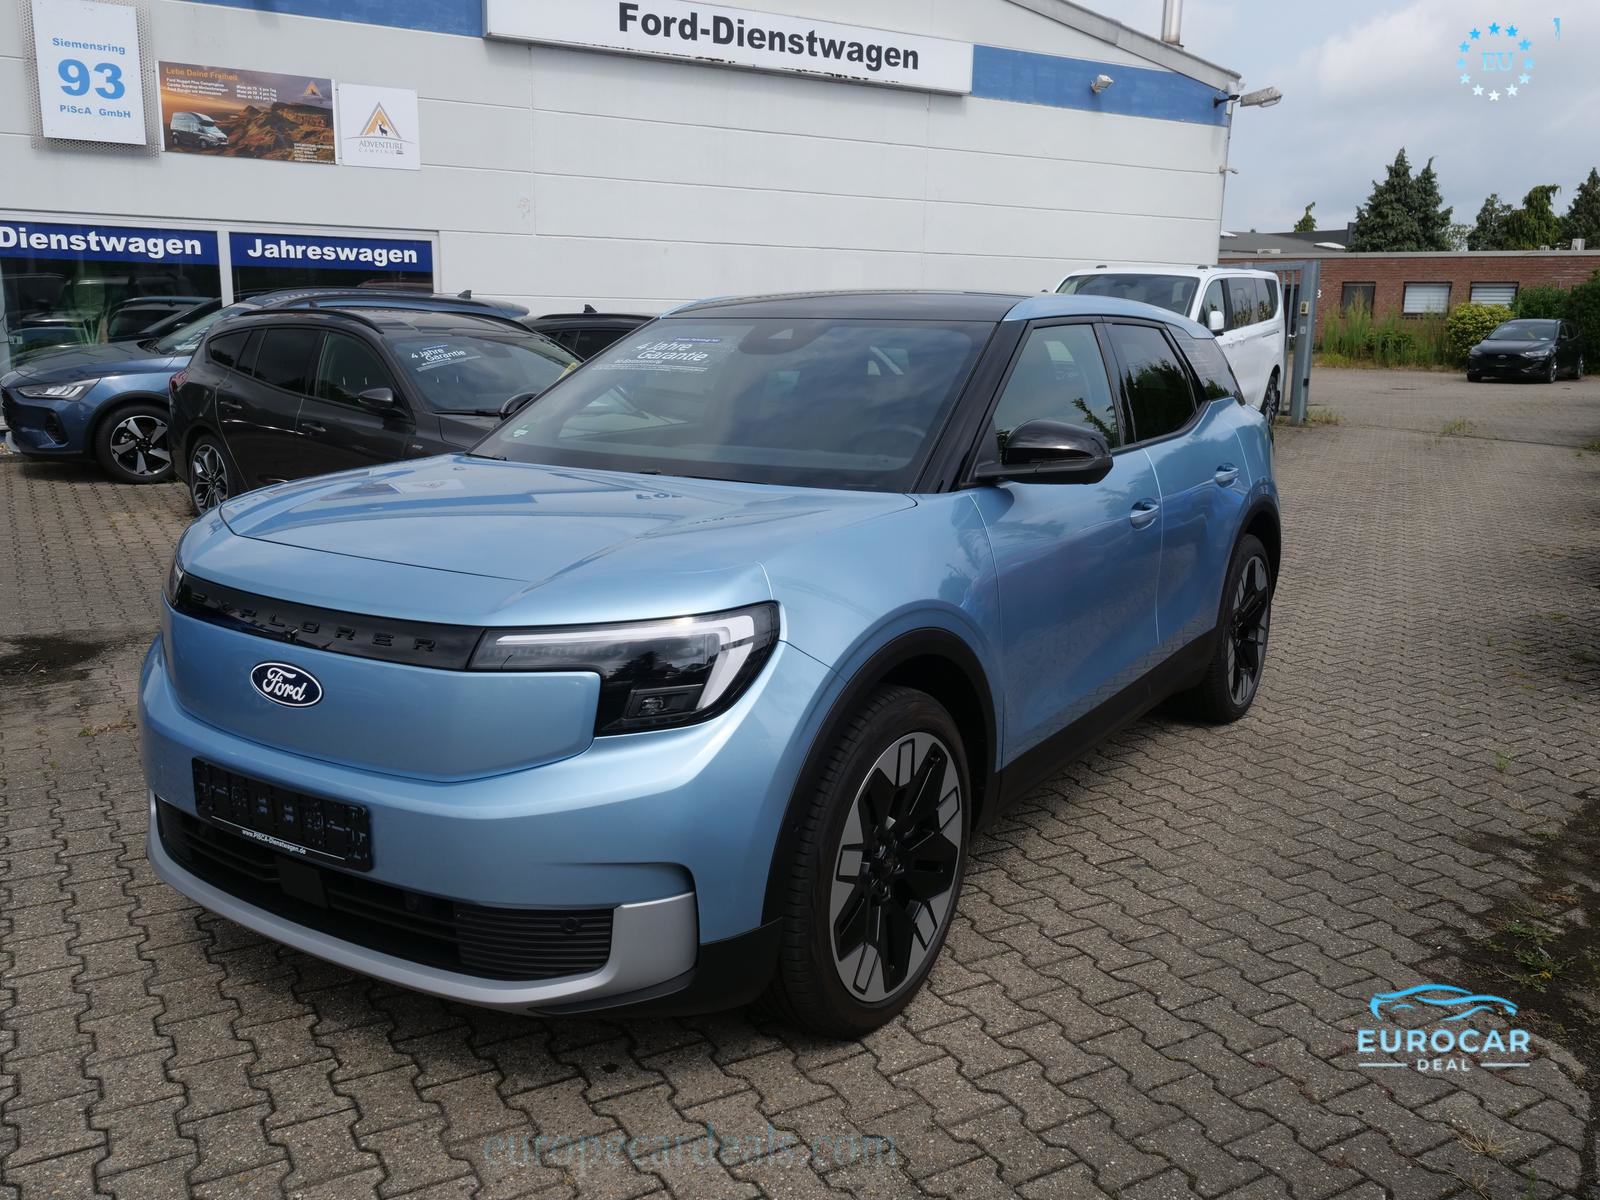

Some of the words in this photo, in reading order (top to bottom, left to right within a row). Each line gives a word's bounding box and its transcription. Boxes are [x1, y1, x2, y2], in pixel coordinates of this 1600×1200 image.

[617, 1, 920, 72] Ford-Dienstwagen
[52, 37, 126, 56] Siemensring
[57, 58, 126, 101] 93
[98, 107, 132, 119] GmbH
[359, 139, 403, 150] ADVENTURE
[0, 226, 202, 259] Dienstwagen
[247, 238, 418, 266] Jahreswagen
[419, 347, 445, 358] Jahre
[636, 350, 709, 361] Garantie
[647, 341, 693, 351] Jahre
[261, 665, 308, 703] Ford
